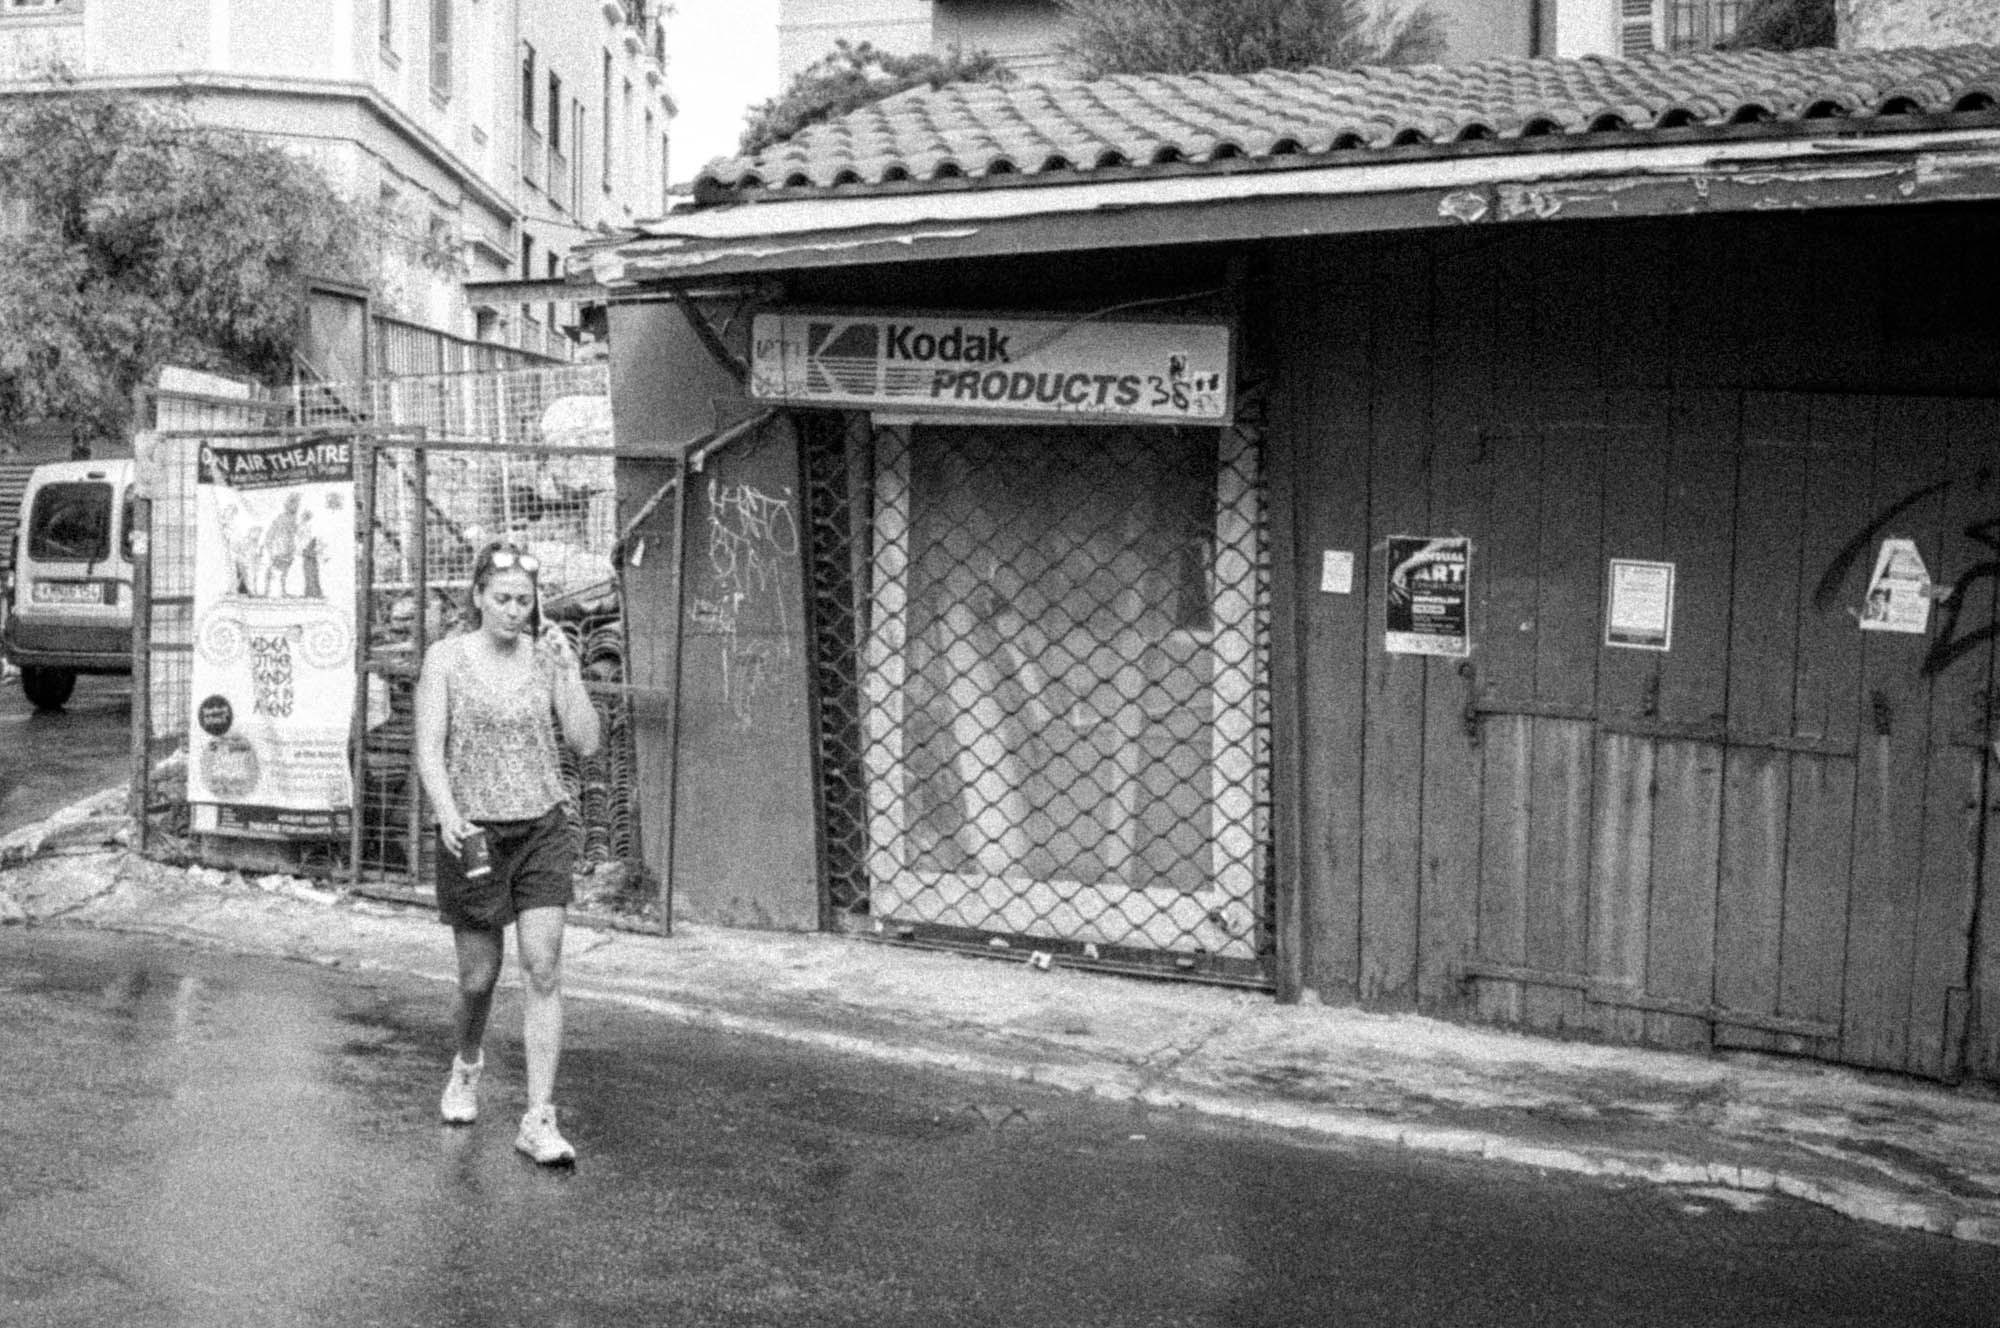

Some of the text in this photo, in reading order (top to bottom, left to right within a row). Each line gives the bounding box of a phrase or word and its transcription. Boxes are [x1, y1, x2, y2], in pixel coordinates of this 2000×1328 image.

[886, 323, 1010, 363] Kodak
[930, 369, 1141, 406] PRODUCTS
[235, 454, 268, 473] AIR
[267, 443, 350, 471] THEATRE
[1413, 563, 1465, 583] ART
